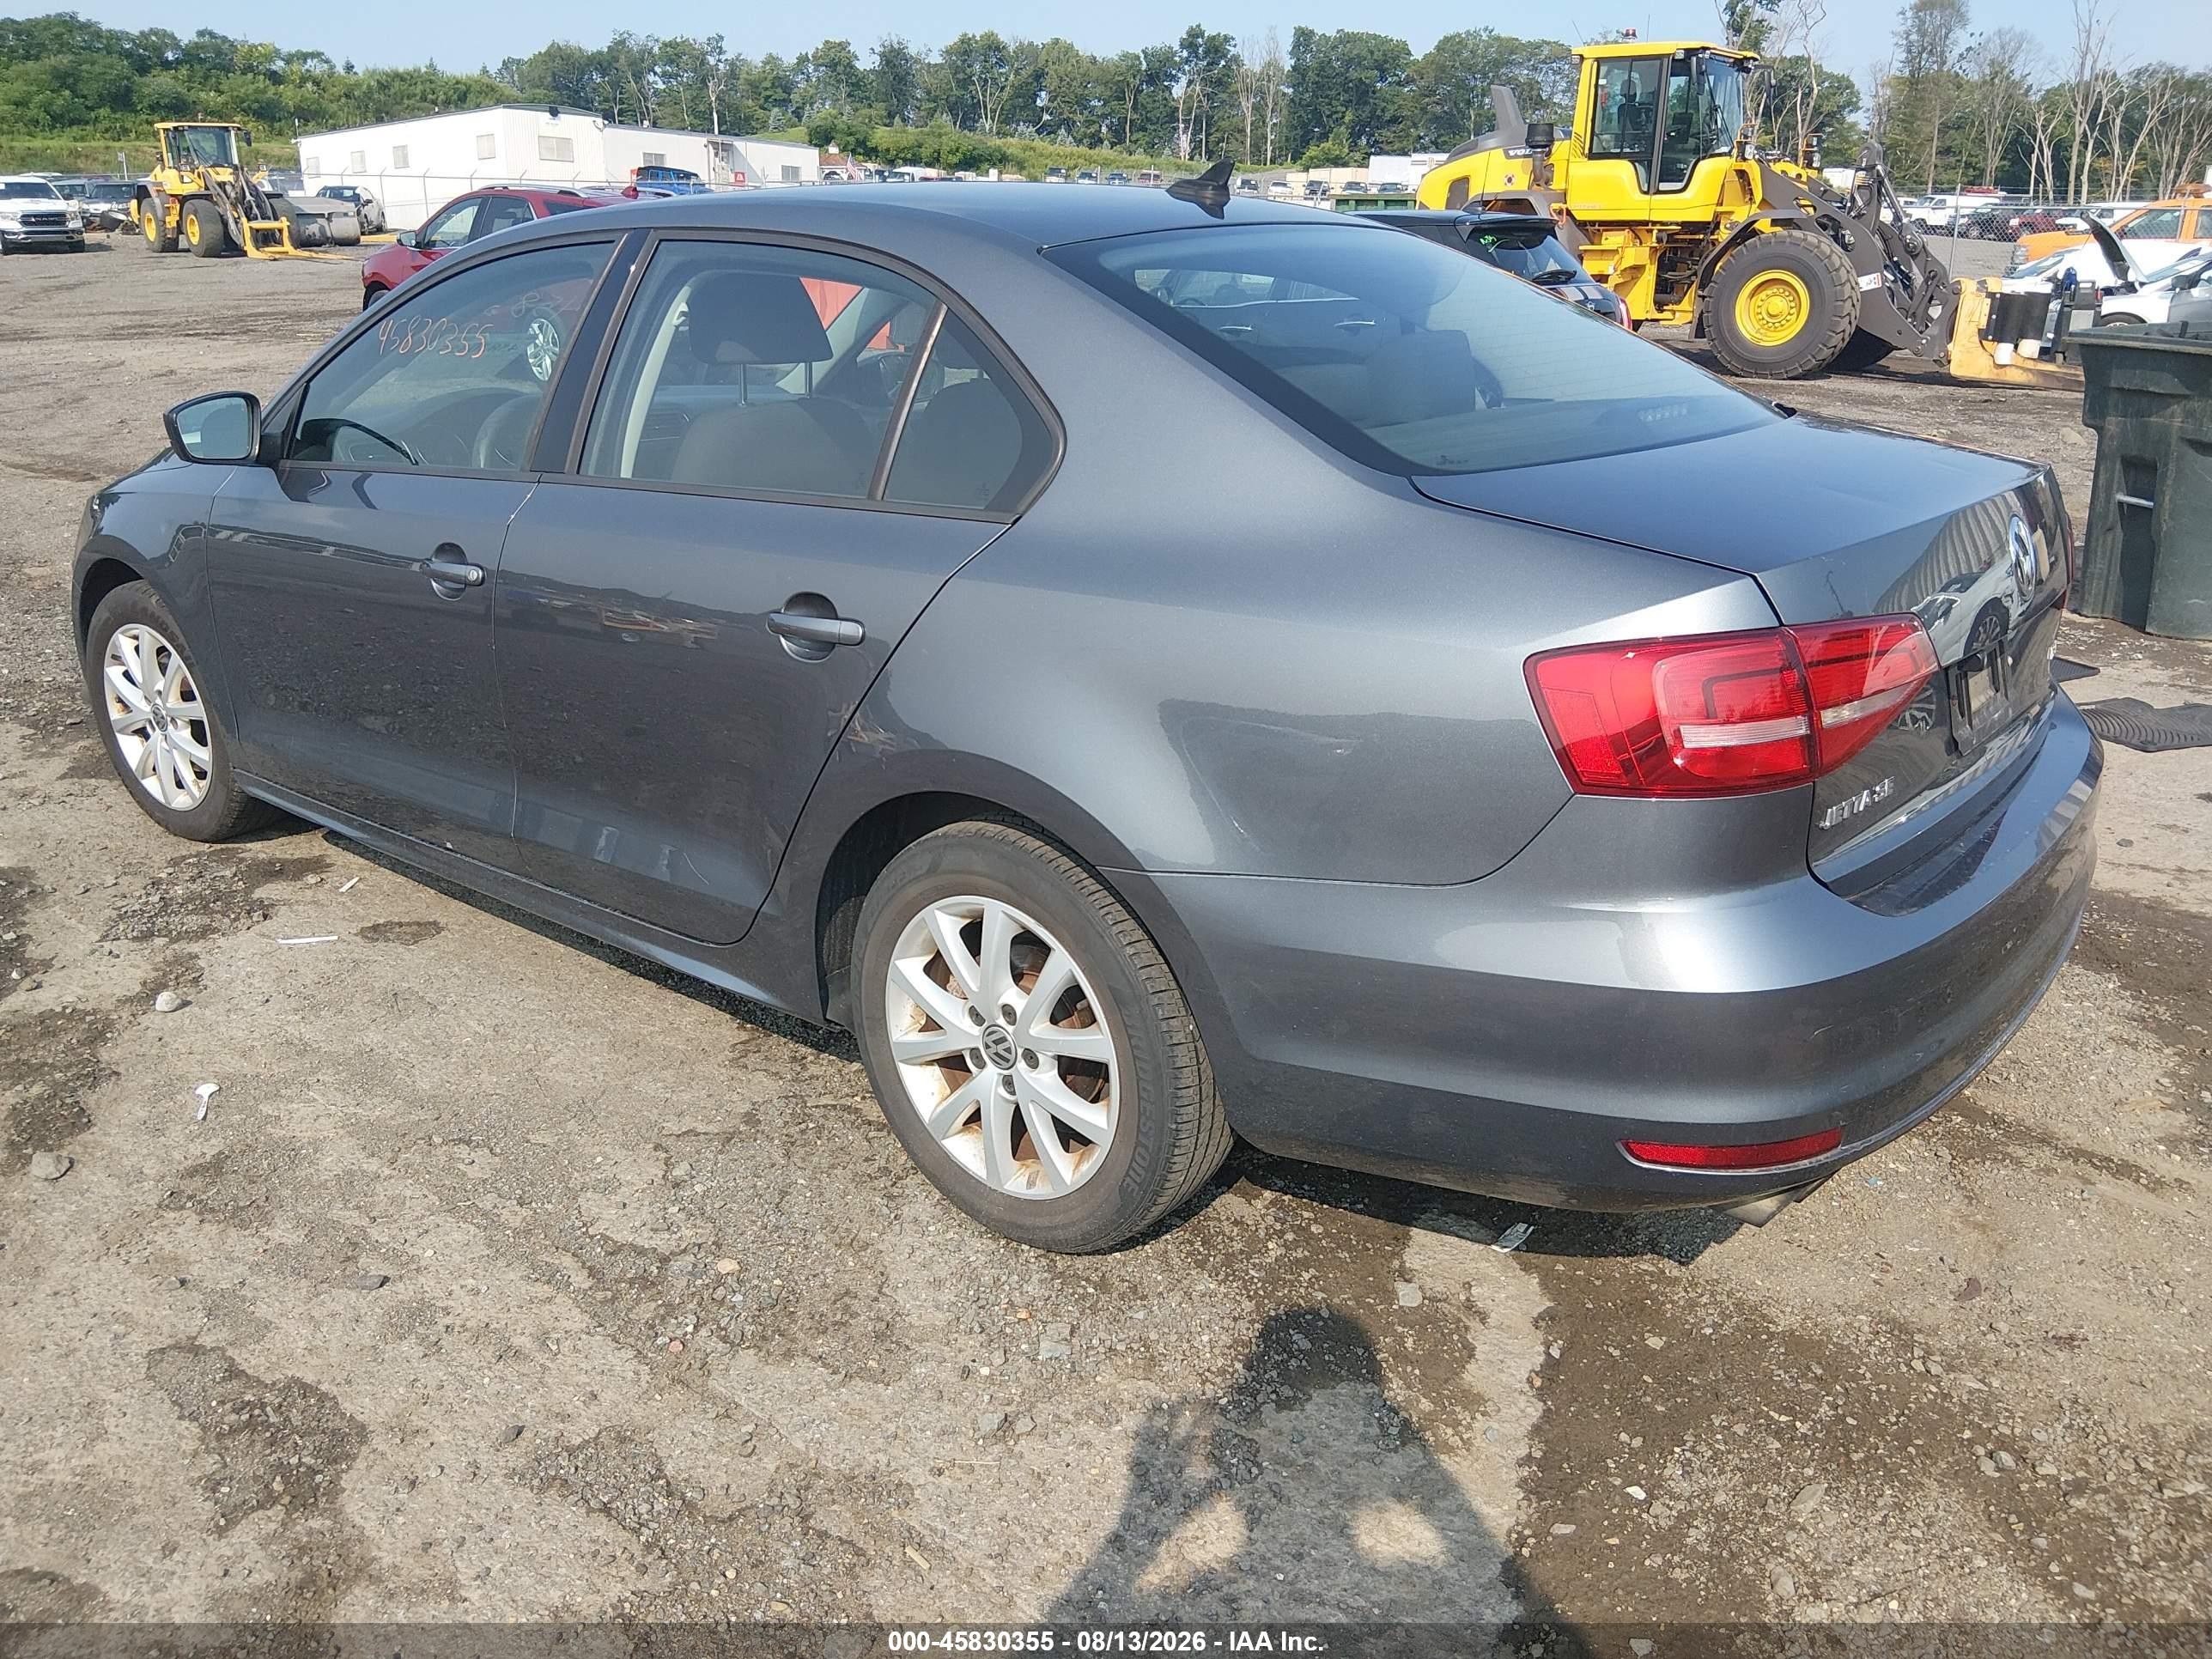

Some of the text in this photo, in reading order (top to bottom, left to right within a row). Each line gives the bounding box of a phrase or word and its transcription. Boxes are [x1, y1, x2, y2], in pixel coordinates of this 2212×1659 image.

[379, 315, 495, 359] 45830355
[1818, 776, 1895, 830] JETTA SE
